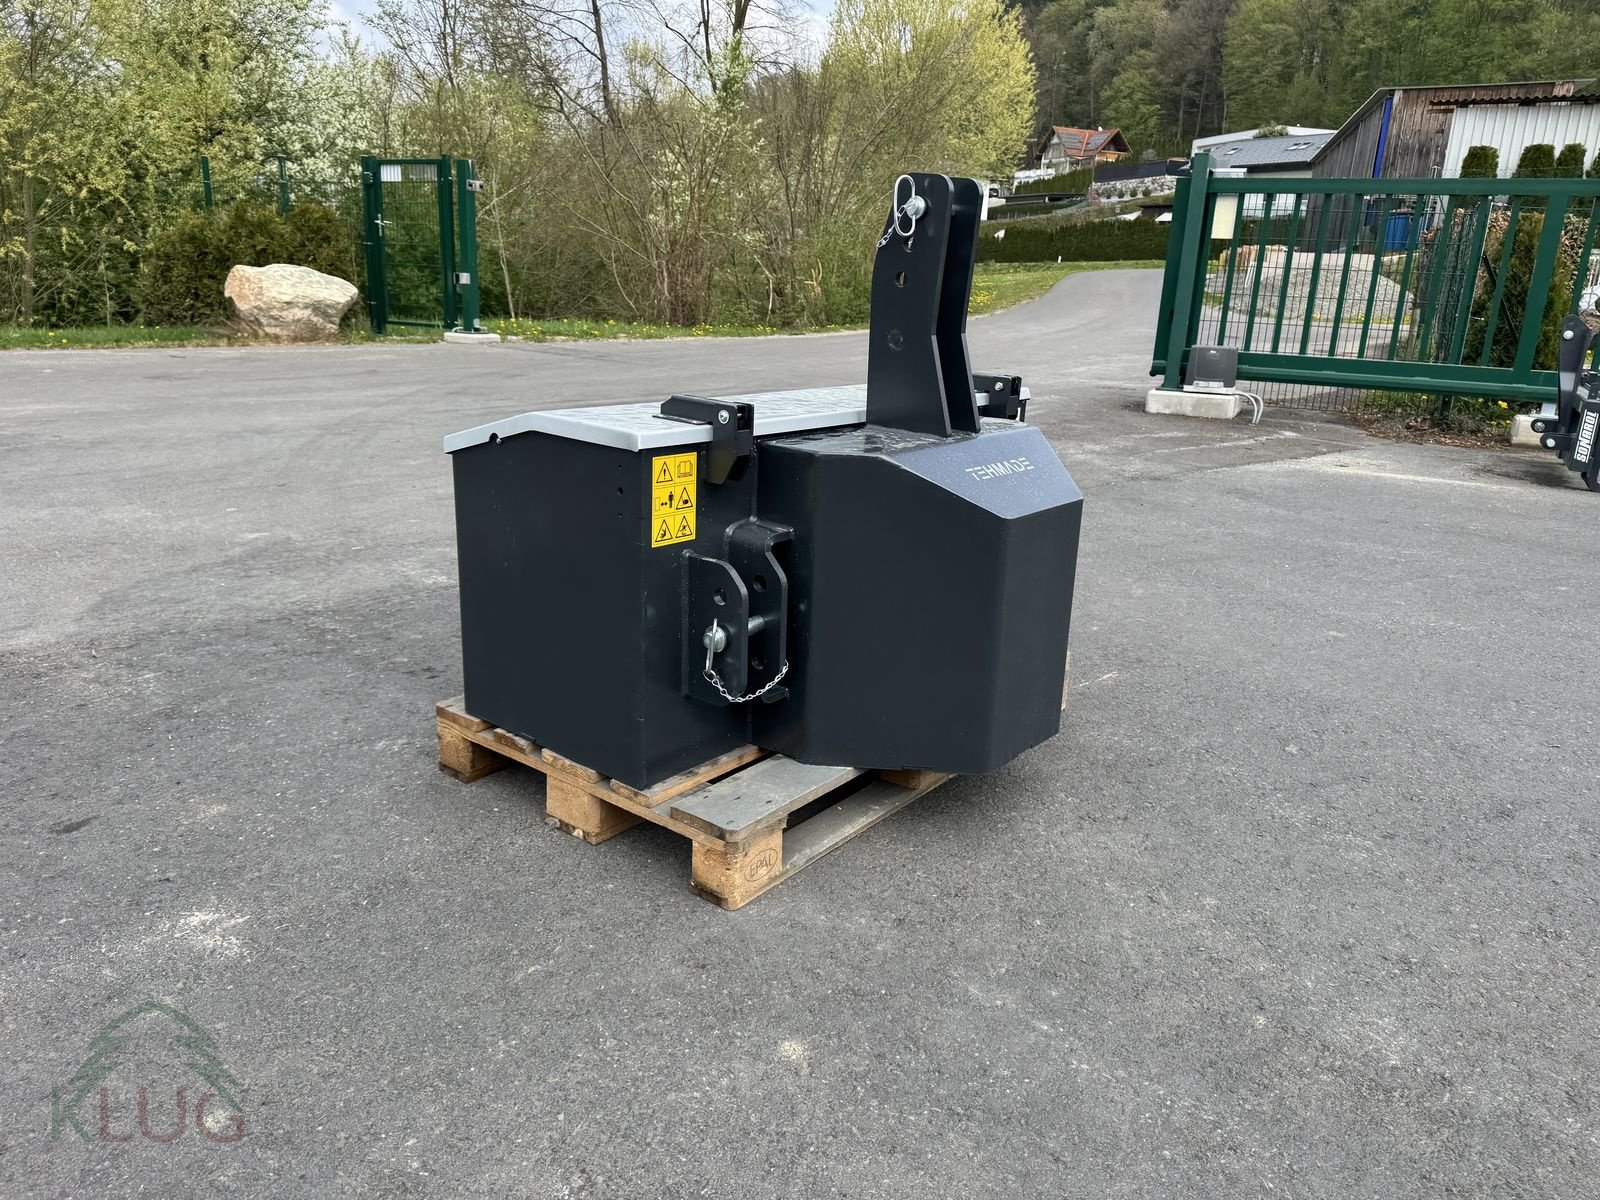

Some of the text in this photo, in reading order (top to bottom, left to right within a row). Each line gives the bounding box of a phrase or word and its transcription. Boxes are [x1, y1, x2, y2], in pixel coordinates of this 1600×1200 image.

[1575, 410, 1598, 463] SONAROL
[965, 457, 1034, 481] TEHMADE
[749, 853, 774, 879] EPAL
